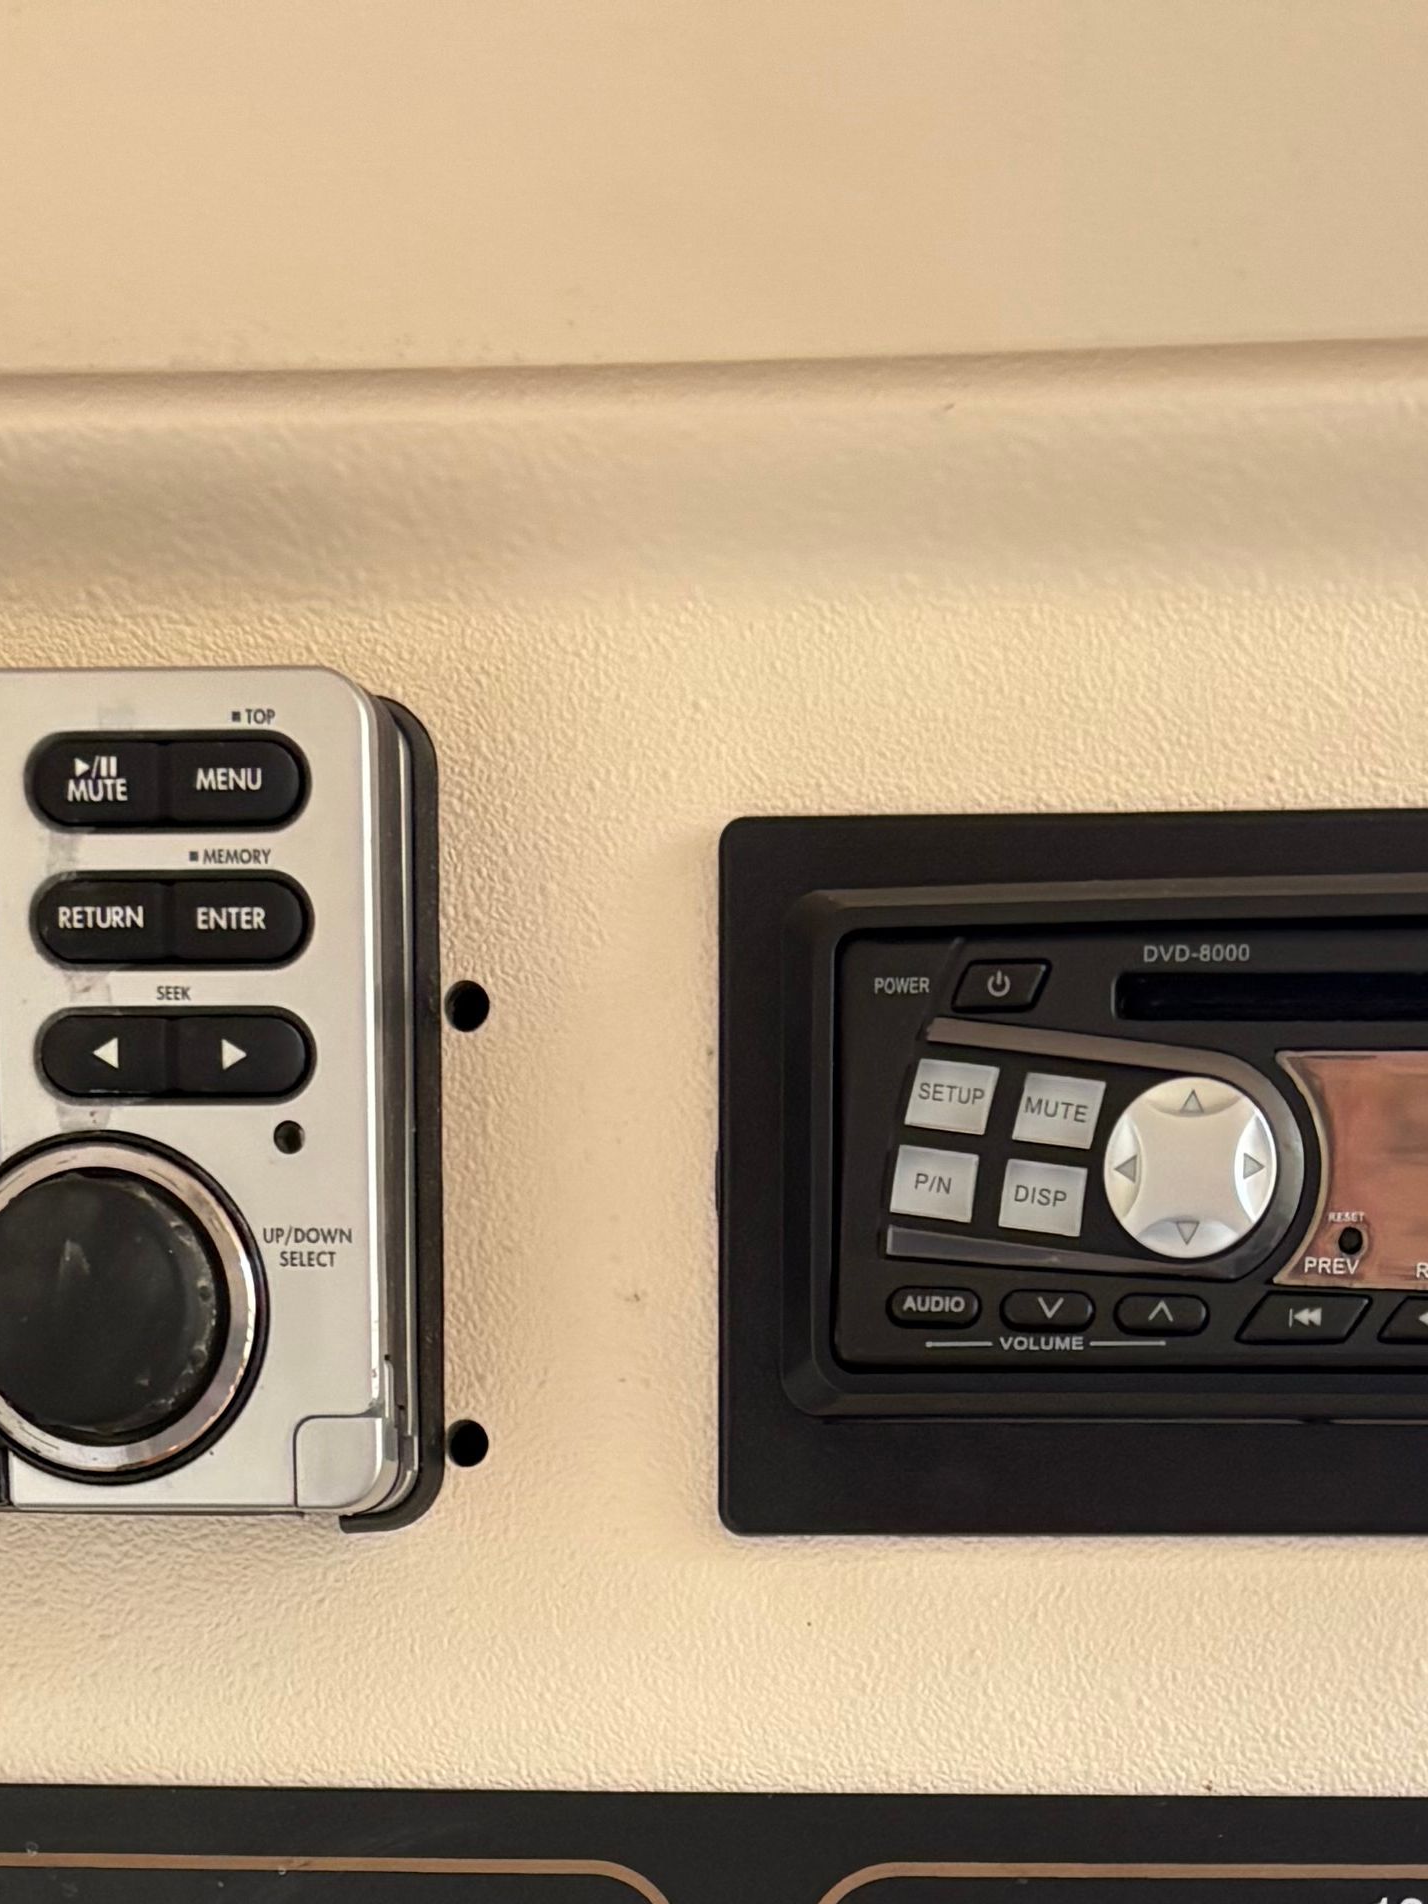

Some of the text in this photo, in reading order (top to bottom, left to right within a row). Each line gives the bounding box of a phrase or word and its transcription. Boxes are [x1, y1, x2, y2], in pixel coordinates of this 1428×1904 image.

[246, 709, 275, 724] TOP
[196, 768, 261, 790] MENU
[68, 778, 127, 801] MUTE
[204, 849, 271, 864] MEMORY
[59, 906, 143, 928] RETURN
[197, 907, 265, 929] ENTER
[1144, 944, 1249, 962] DVD-8000
[157, 986, 190, 1000] SEEK
[875, 977, 929, 994] POWER
[918, 1083, 984, 1104] SETUP
[1025, 1096, 1088, 1123] MUTE
[915, 1173, 951, 1194] P/N
[1014, 1185, 1066, 1206] DISP
[263, 1227, 352, 1245] UP/DOWN
[280, 1251, 336, 1267] SELECT
[1305, 1257, 1359, 1274] PREV
[903, 1296, 965, 1312] AUDIO
[1000, 1336, 1083, 1350] VOLUME
